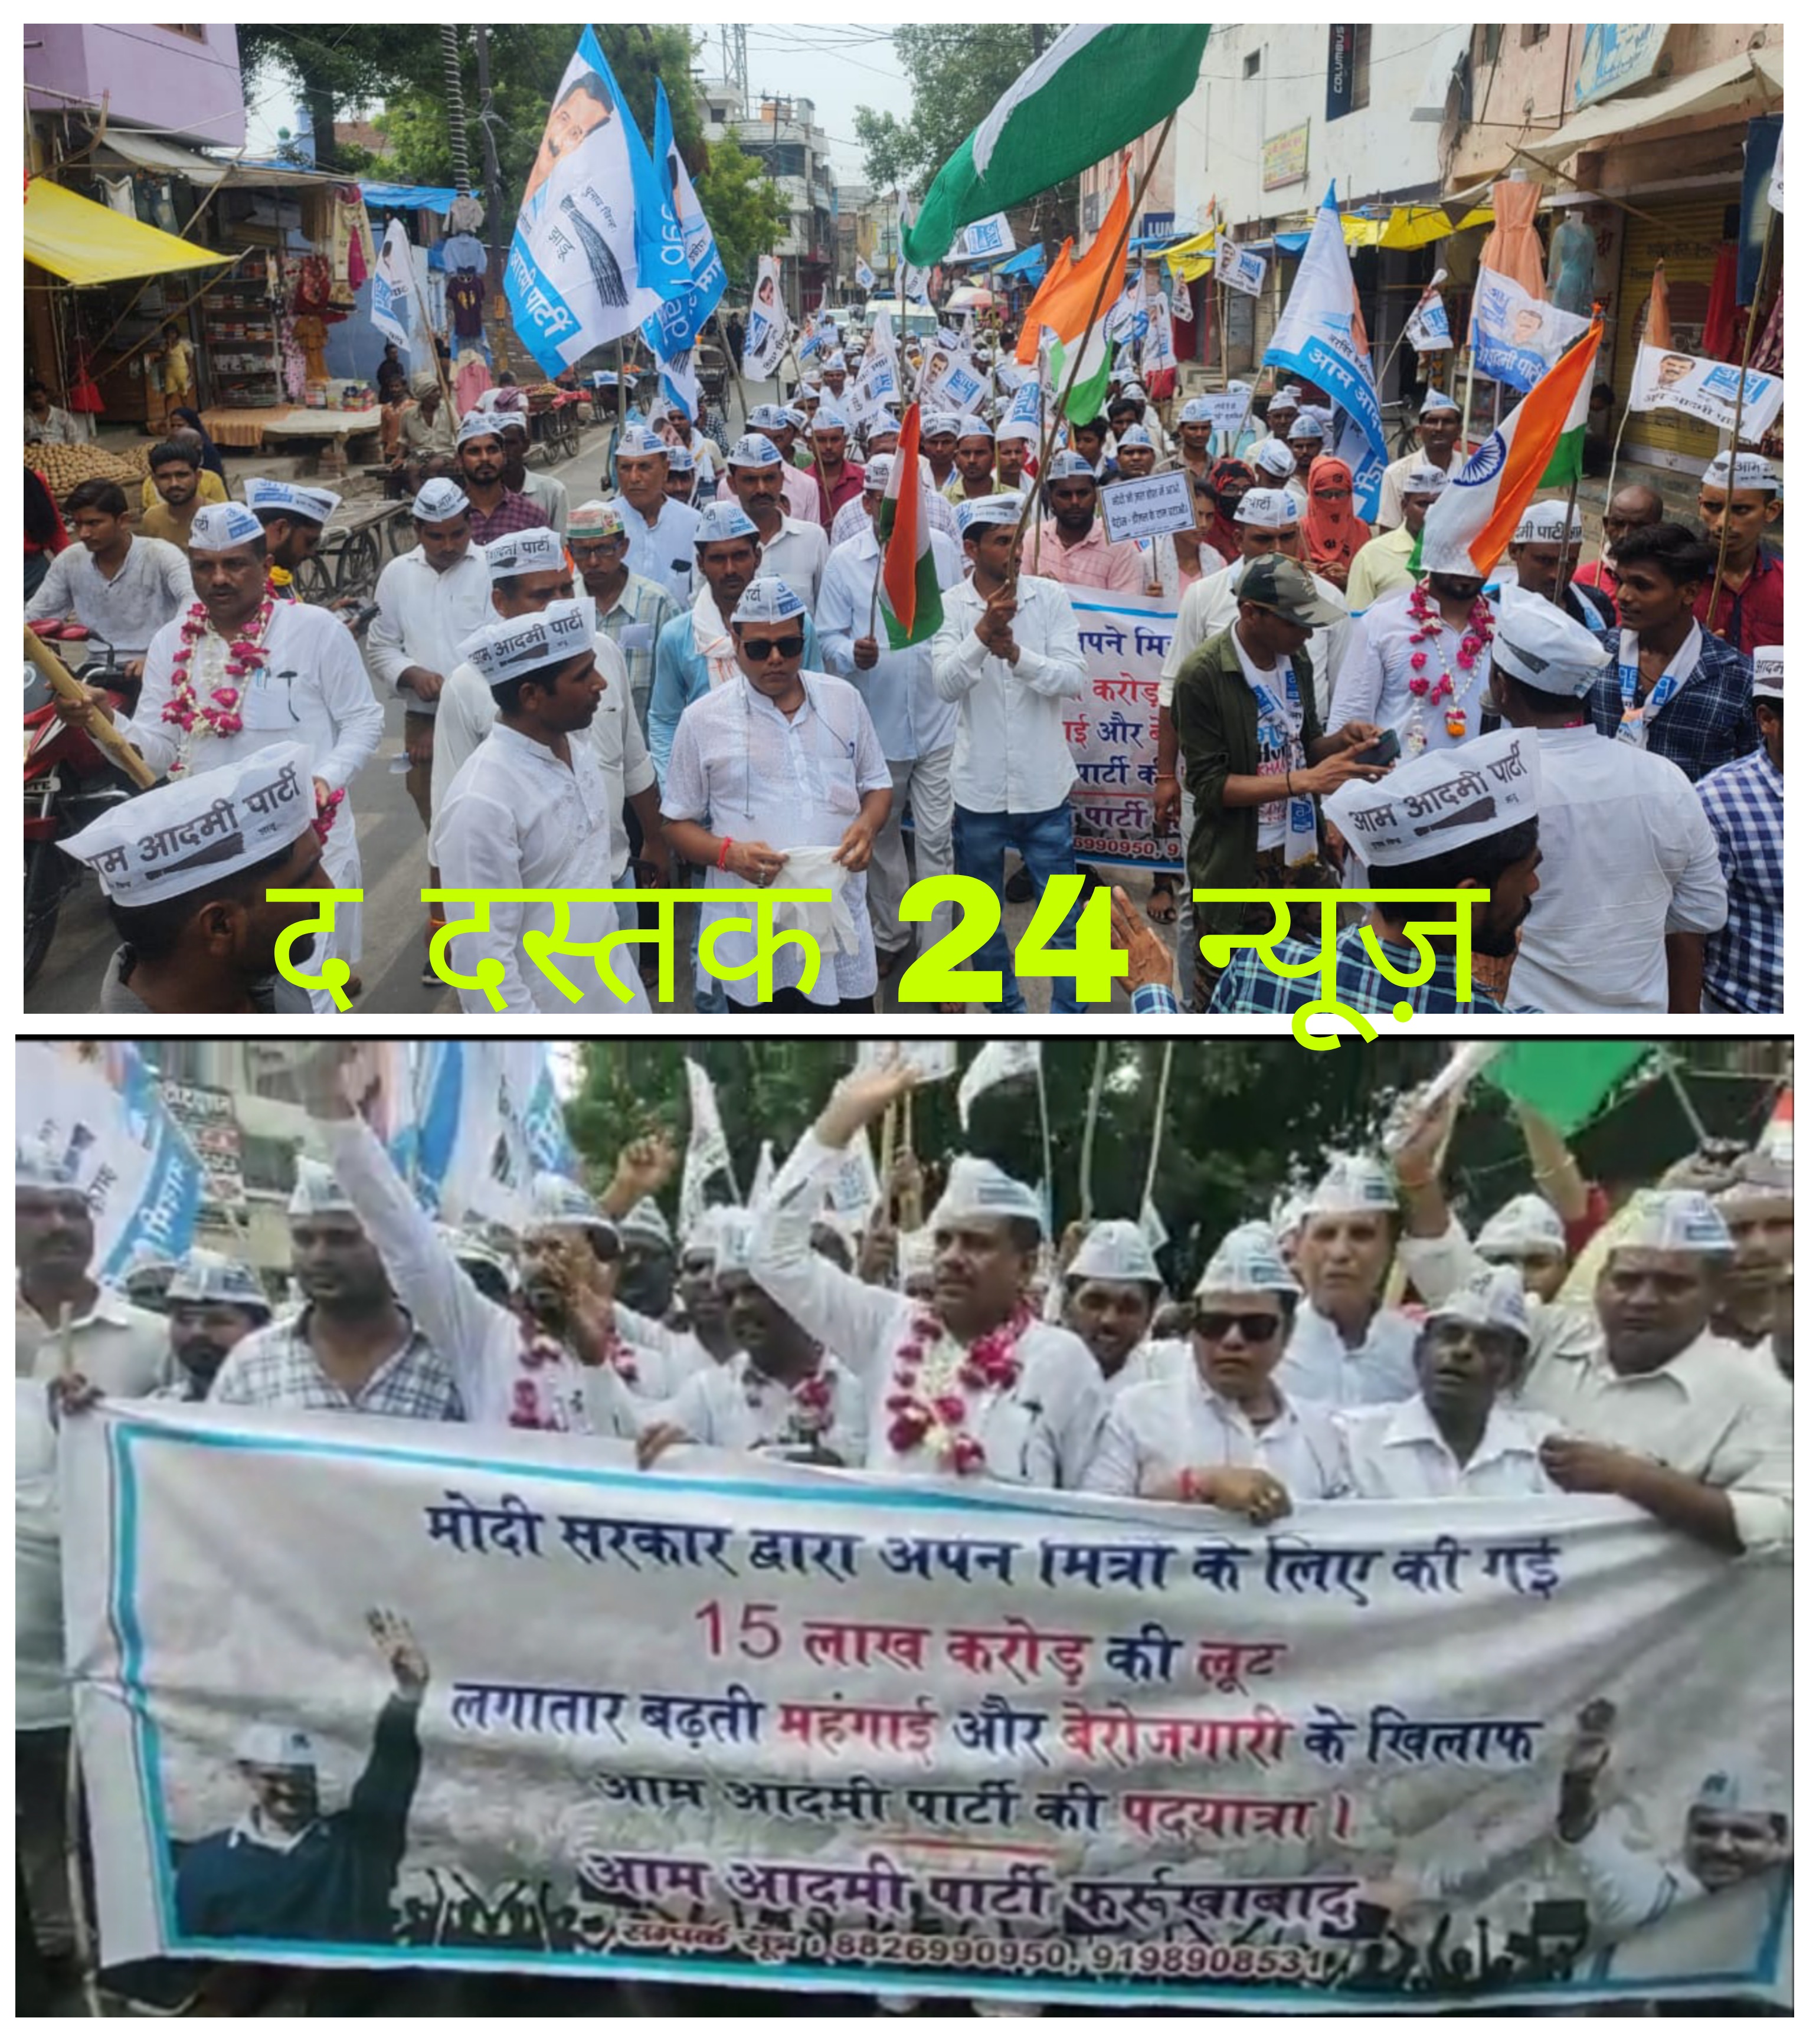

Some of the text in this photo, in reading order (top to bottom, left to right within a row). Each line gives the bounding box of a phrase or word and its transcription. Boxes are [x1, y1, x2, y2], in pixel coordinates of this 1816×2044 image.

[1333, 25, 1344, 94] COLUMBUS
[525, 287, 574, 339] पार्टी
[1308, 346, 1356, 389] आम
[521, 535, 552, 555] पार्टी
[494, 623, 548, 657] आदमी
[549, 607, 585, 635] पार्टी
[1078, 624, 1127, 656] पने
[1092, 671, 1161, 708] करोड़
[1097, 712, 1144, 749] और
[136, 797, 240, 865] आदमी
[241, 759, 302, 816] पार्टी
[1348, 802, 1399, 833] आम
[1402, 769, 1490, 819] आदमी
[1486, 739, 1529, 784] पार्टी
[1085, 800, 1150, 830] पार्टी
[424, 1490, 548, 1559] मोदी
[559, 1513, 739, 1578] सरकार
[748, 1527, 863, 1584] द्वारा
[1265, 1530, 1384, 1607] लिए
[1392, 1534, 1471, 1594] की
[1481, 1536, 1563, 1600] गई
[694, 1599, 1289, 1696] 15 लाख करोड़ की लूट
[451, 1681, 1544, 1770] लगातार बढ़ती महंगाई और बेरोजगारी के खिलाफ
[595, 1772, 707, 1809] आम
[721, 1774, 891, 1823] आदमी
[906, 1780, 1022, 1829] पार्टी
[1035, 1781, 1109, 1830] की
[1121, 1794, 1317, 1840] पदयात्रा
[582, 1852, 714, 1901] आम
[726, 1851, 914, 1912] आदमी
[928, 1863, 1056, 1918] पार्टी
[835, 1932, 1079, 1974] 8826990950,
[1091, 1944, 1321, 1978] 9198908531
